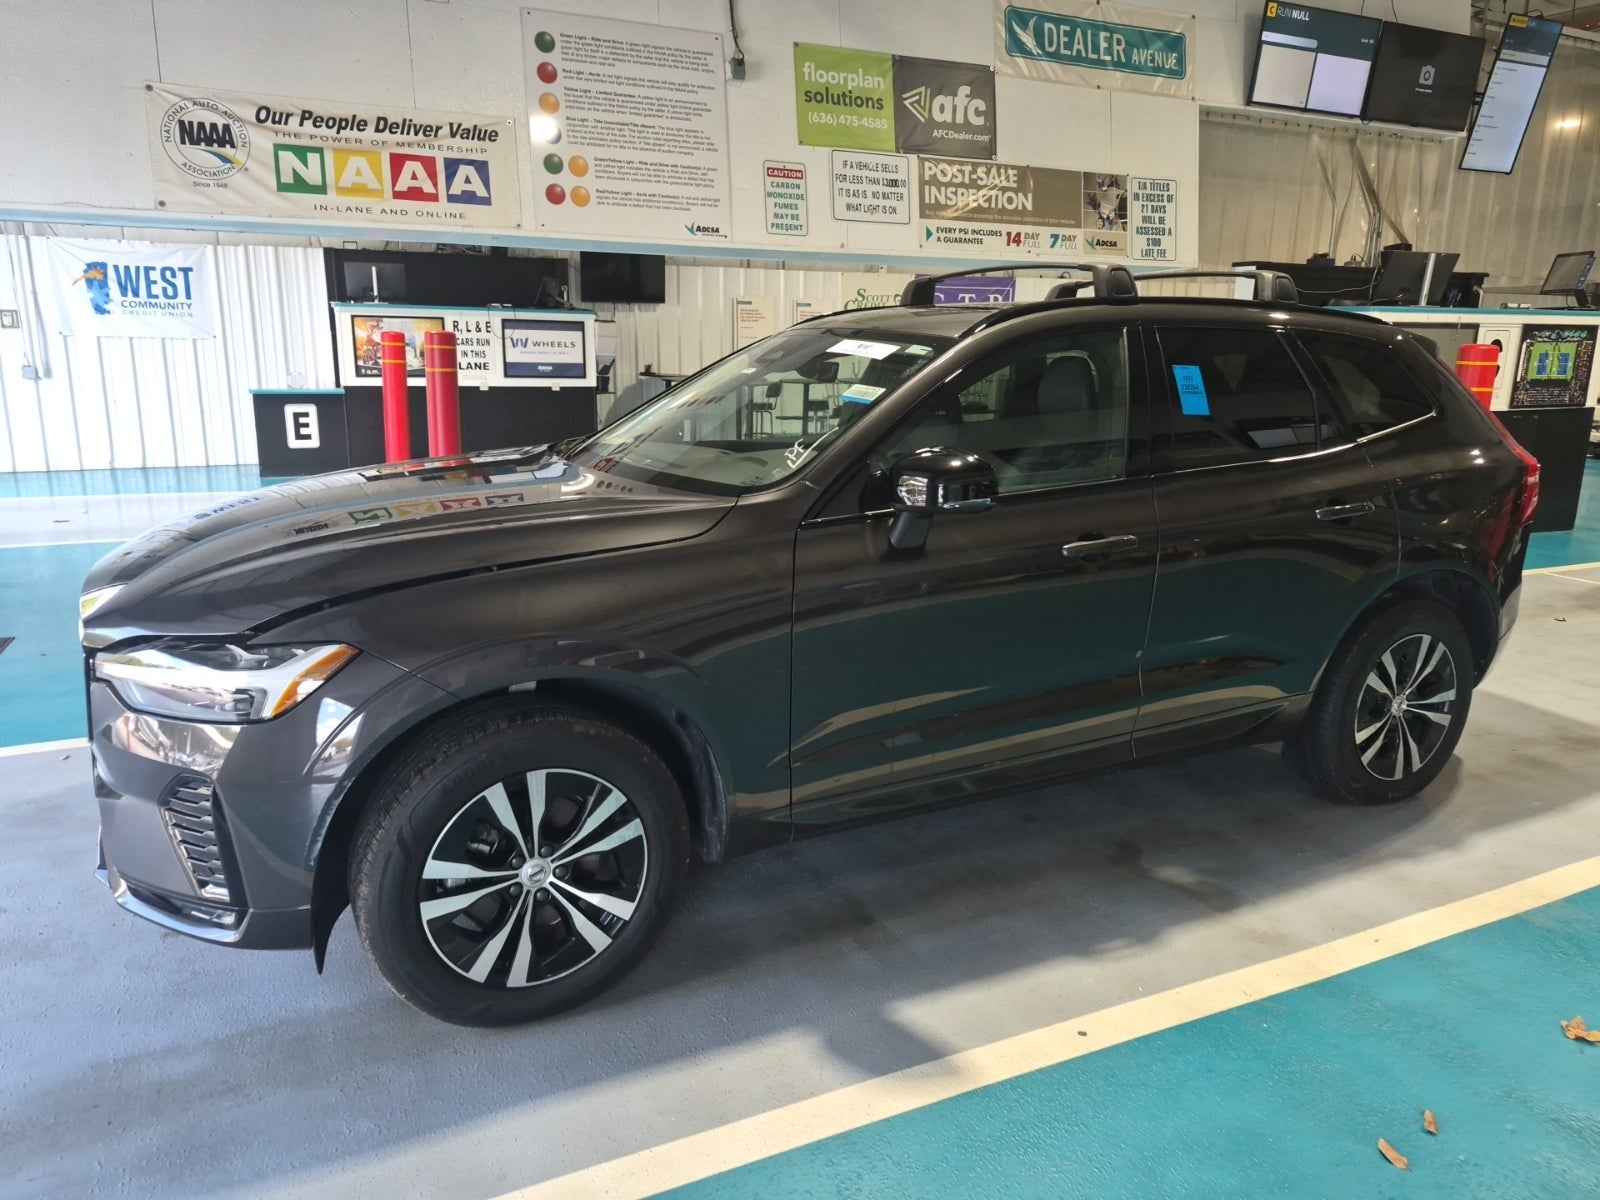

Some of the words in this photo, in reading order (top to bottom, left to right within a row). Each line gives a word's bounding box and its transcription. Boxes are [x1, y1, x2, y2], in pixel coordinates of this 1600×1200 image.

[1278, 6, 1292, 18] RUN
[1291, 9, 1310, 21] NULL
[1044, 22, 1126, 63] DEALER
[1131, 47, 1179, 70] AVENUE
[803, 61, 884, 90] floorplan
[804, 86, 884, 110] solutions
[931, 85, 986, 125] afc
[163, 103, 190, 143] NATIONAL
[192, 101, 219, 111] AUTO
[222, 110, 248, 148] AUCTION
[255, 106, 293, 126] Our
[299, 109, 368, 135] People
[374, 116, 443, 138] Deliver
[449, 122, 499, 143] Value
[808, 111, 837, 126] (636)
[838, 115, 887, 129] 475-4585
[178, 120, 236, 149] NAAA
[932, 129, 989, 142] AFCDealer.com
[273, 131, 302, 140] THE
[310, 134, 363, 145] POWER
[396, 142, 487, 154] MEMBERSHIP
[181, 162, 235, 177] ASSOCIATION
[842, 160, 848, 169] IF
[849, 160, 854, 170] A
[855, 161, 879, 172] VEHICLE
[880, 163, 899, 174] SELLS
[768, 169, 802, 179] CAUTION
[835, 173, 848, 183] FOR
[848, 174, 863, 185] LESS
[865, 176, 880, 186] THAN
[924, 161, 1018, 188] POST-SALE
[770, 181, 801, 190] CARBON
[1138, 181, 1147, 191] T/A
[1149, 181, 1170, 192] TITLES
[766, 191, 805, 201] MONOXIDE
[838, 188, 844, 197] IT
[845, 188, 851, 198] IS
[852, 189, 860, 198] AS
[871, 190, 880, 200] NO
[881, 191, 904, 201] MATTER
[924, 185, 1033, 211] INSPECTION
[1133, 192, 1140, 202] IN
[1141, 193, 1165, 203] EXCESS
[1166, 194, 1174, 204] OF
[313, 204, 373, 215] IN-LANE
[380, 208, 408, 217] AND
[415, 211, 467, 220] ONLINE
[774, 202, 799, 211] FUMES
[845, 202, 863, 212] WHAT
[863, 203, 880, 214] LIGHT
[881, 205, 887, 214] IS
[1141, 203, 1148, 214] 21
[1150, 204, 1167, 214] DAYS
[773, 212, 790, 221] MAY
[790, 213, 800, 221] BE
[1141, 215, 1156, 225] WILL
[1158, 216, 1166, 226] BE
[696, 225, 720, 234] ADESA
[770, 222, 803, 231] PRESENT
[936, 226, 957, 234] EVERY
[959, 227, 969, 235] PSI
[971, 228, 1003, 237] INCLUDES
[1135, 225, 1166, 237] ASSESSED
[1167, 227, 1173, 237] A
[943, 236, 984, 245] GUARANTEE
[1005, 231, 1022, 247] 14
[1024, 232, 1040, 241] DAY
[1022, 239, 1041, 248] FULL
[1049, 233, 1060, 249] 7
[1061, 234, 1077, 243] DAY
[1096, 239, 1117, 248] ADESA
[1059, 241, 1078, 250] FULL
[1141, 248, 1155, 258] LATE
[1156, 249, 1167, 259] FEE
[112, 264, 194, 300] WEST
[120, 299, 193, 311] COMMUNITY
[122, 309, 157, 317] CREDIT
[466, 321, 472, 332] L
[475, 321, 482, 333] &
[485, 321, 491, 333] E
[455, 337, 474, 346] CARS
[476, 338, 491, 347] RUN
[532, 340, 576, 349] WHEELS
[461, 350, 469, 358] IN
[470, 350, 486, 358] THIS
[458, 362, 490, 371] LANE
[292, 411, 312, 441] E
